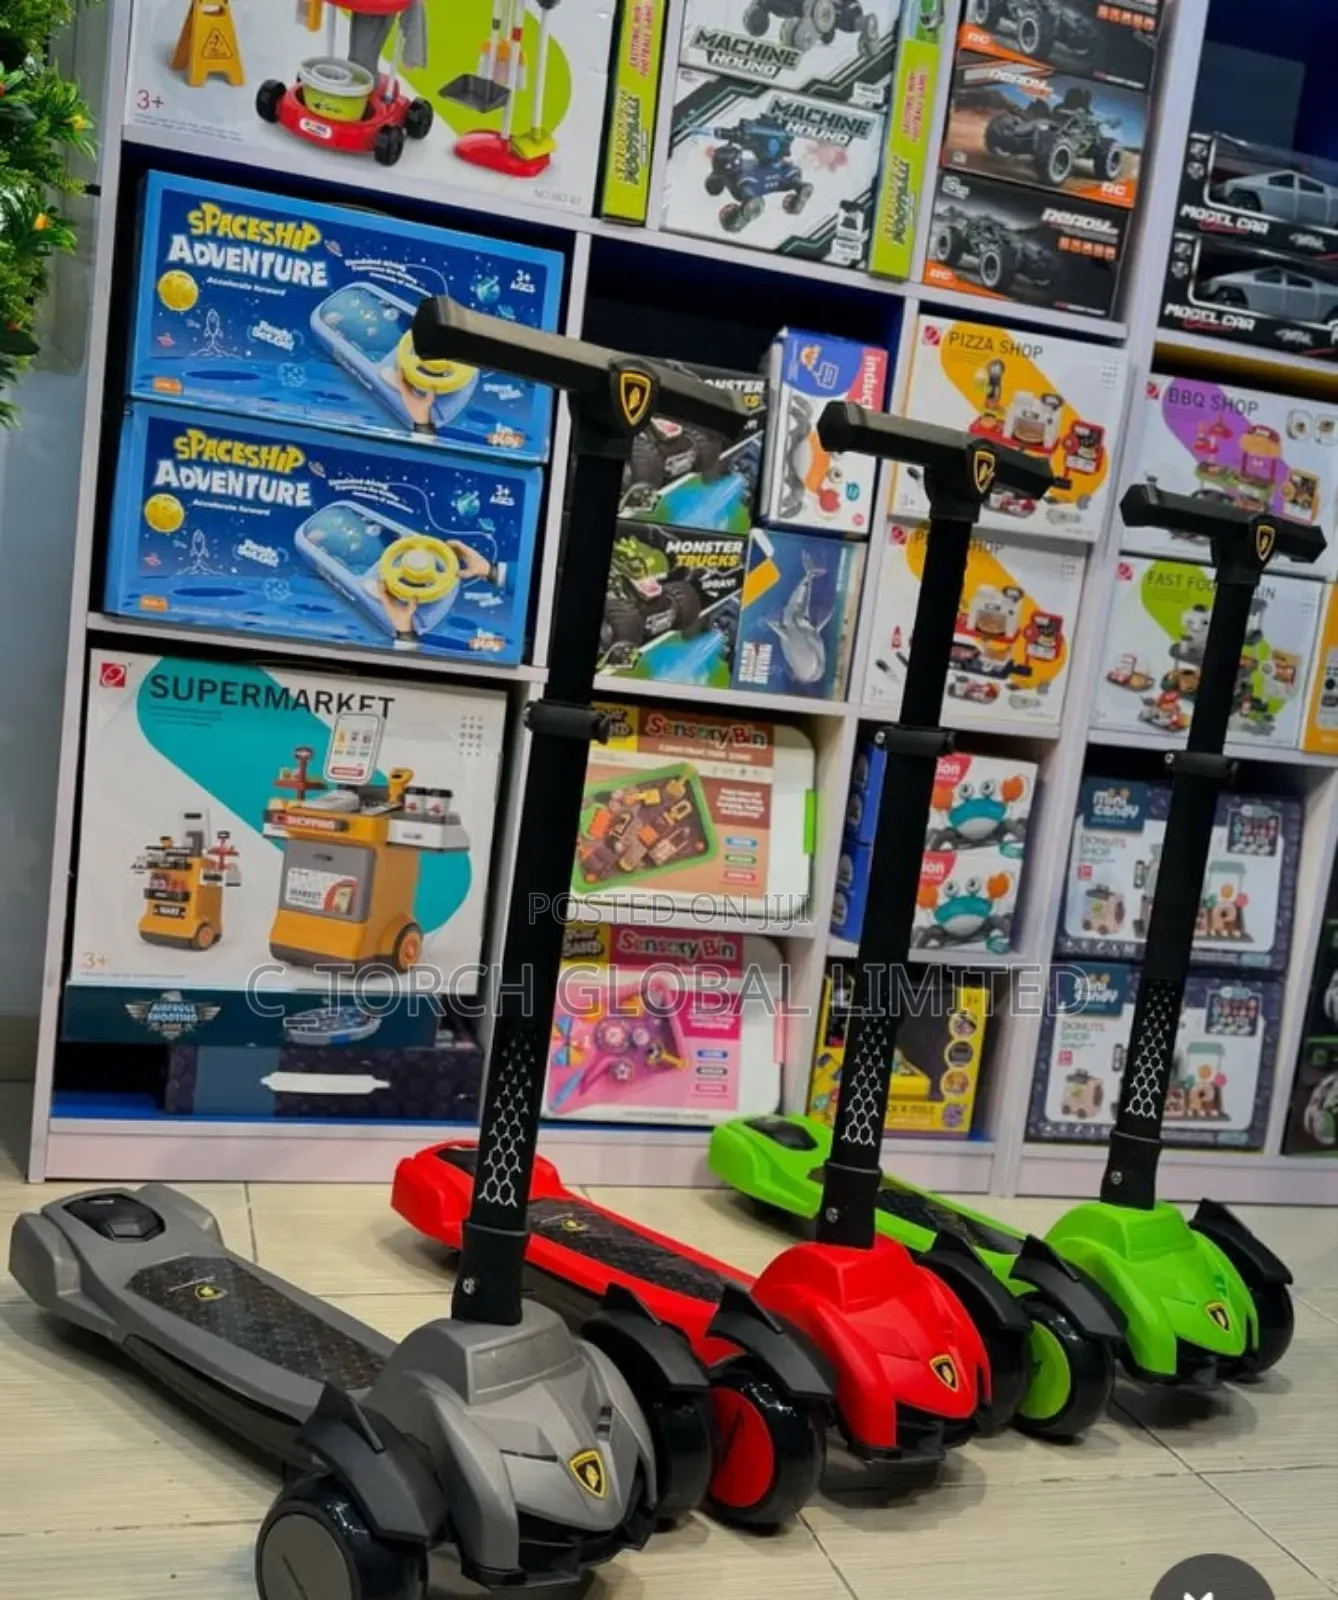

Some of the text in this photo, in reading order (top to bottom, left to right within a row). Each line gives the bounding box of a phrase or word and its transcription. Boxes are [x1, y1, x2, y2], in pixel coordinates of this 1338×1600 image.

[693, 29, 800, 68] MACHINE
[708, 52, 781, 77] HOUND
[136, 88, 165, 110] 3+
[769, 99, 873, 135] MACHINE
[784, 121, 850, 145] HOUND
[187, 201, 322, 252] SPACESHIP
[1180, 204, 1270, 235] MODEL CAR
[165, 234, 329, 288] ADVENTURE
[1164, 303, 1257, 333] MODEL CAR
[948, 331, 1044, 360] PIZZA SHOP
[1166, 387, 1259, 416] BBQ SHOP
[173, 428, 306, 475] SPACESHIP
[153, 459, 313, 507] ADVENTURE
[666, 540, 743, 555] MONSTER
[676, 555, 742, 568] TRUCKS
[1147, 571, 1183, 588] FAST
[149, 673, 397, 721] SUPERMARKET
[646, 711, 728, 750] Sensory
[729, 724, 768, 750] Bin
[616, 929, 699, 960] Sensory
[702, 937, 737, 961] Bin
[82, 951, 108, 970] 3+
